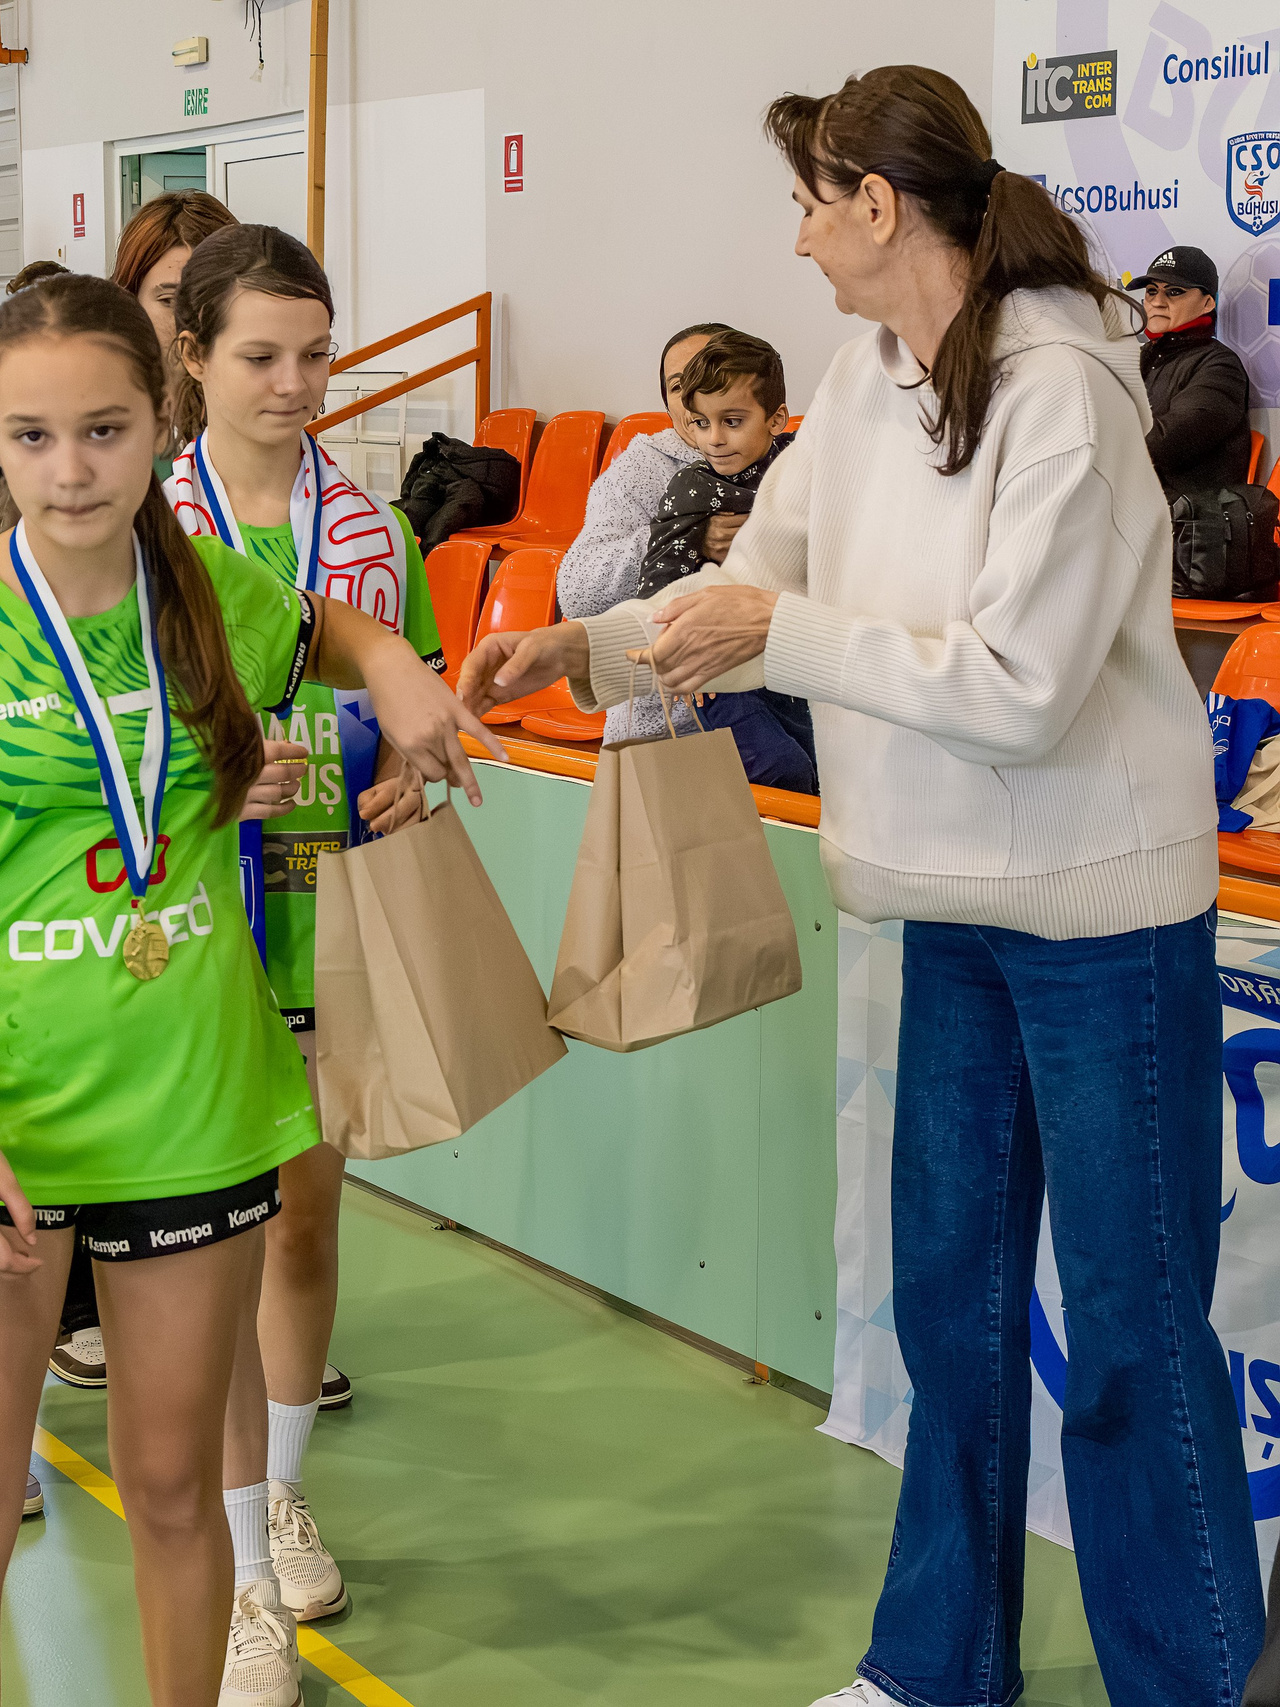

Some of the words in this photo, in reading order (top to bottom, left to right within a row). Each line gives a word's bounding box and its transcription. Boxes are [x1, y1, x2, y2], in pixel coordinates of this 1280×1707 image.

[1077, 60, 1113, 78] INTER
[1163, 40, 1269, 84] Consiliul
[1072, 76, 1113, 95] TRANS
[1084, 93, 1112, 109] COM
[228, 1201, 269, 1229] Kempa
[150, 1222, 213, 1249] Kempa
